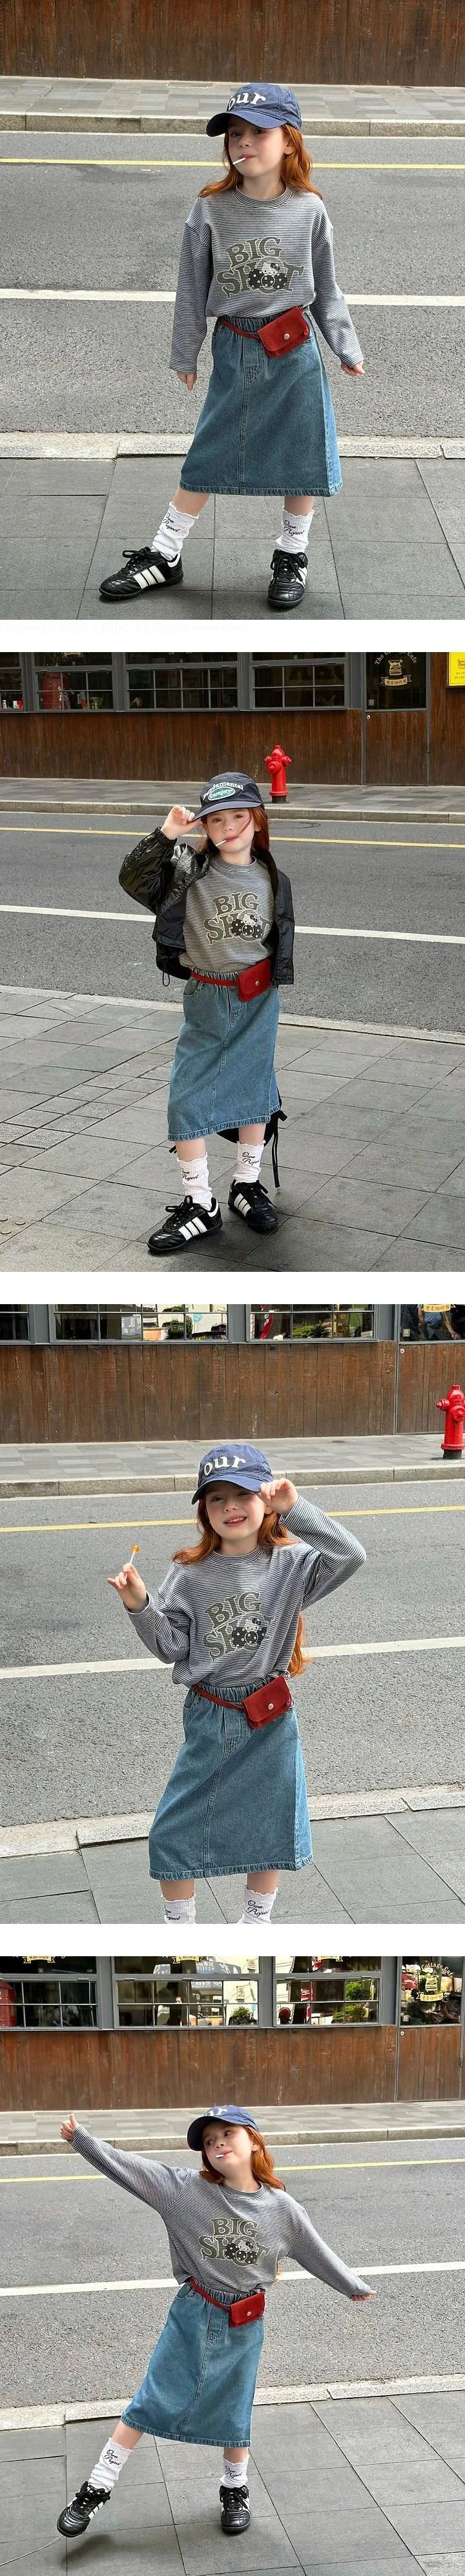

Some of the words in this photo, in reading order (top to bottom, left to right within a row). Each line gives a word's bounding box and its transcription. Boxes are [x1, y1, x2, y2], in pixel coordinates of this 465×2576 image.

[228, 92, 266, 111] our
[225, 237, 283, 269] BIG
[212, 892, 260, 916] BIG
[203, 1455, 246, 1477] our
[204, 1591, 262, 1629] BIG
[211, 2217, 259, 2238] BIG
